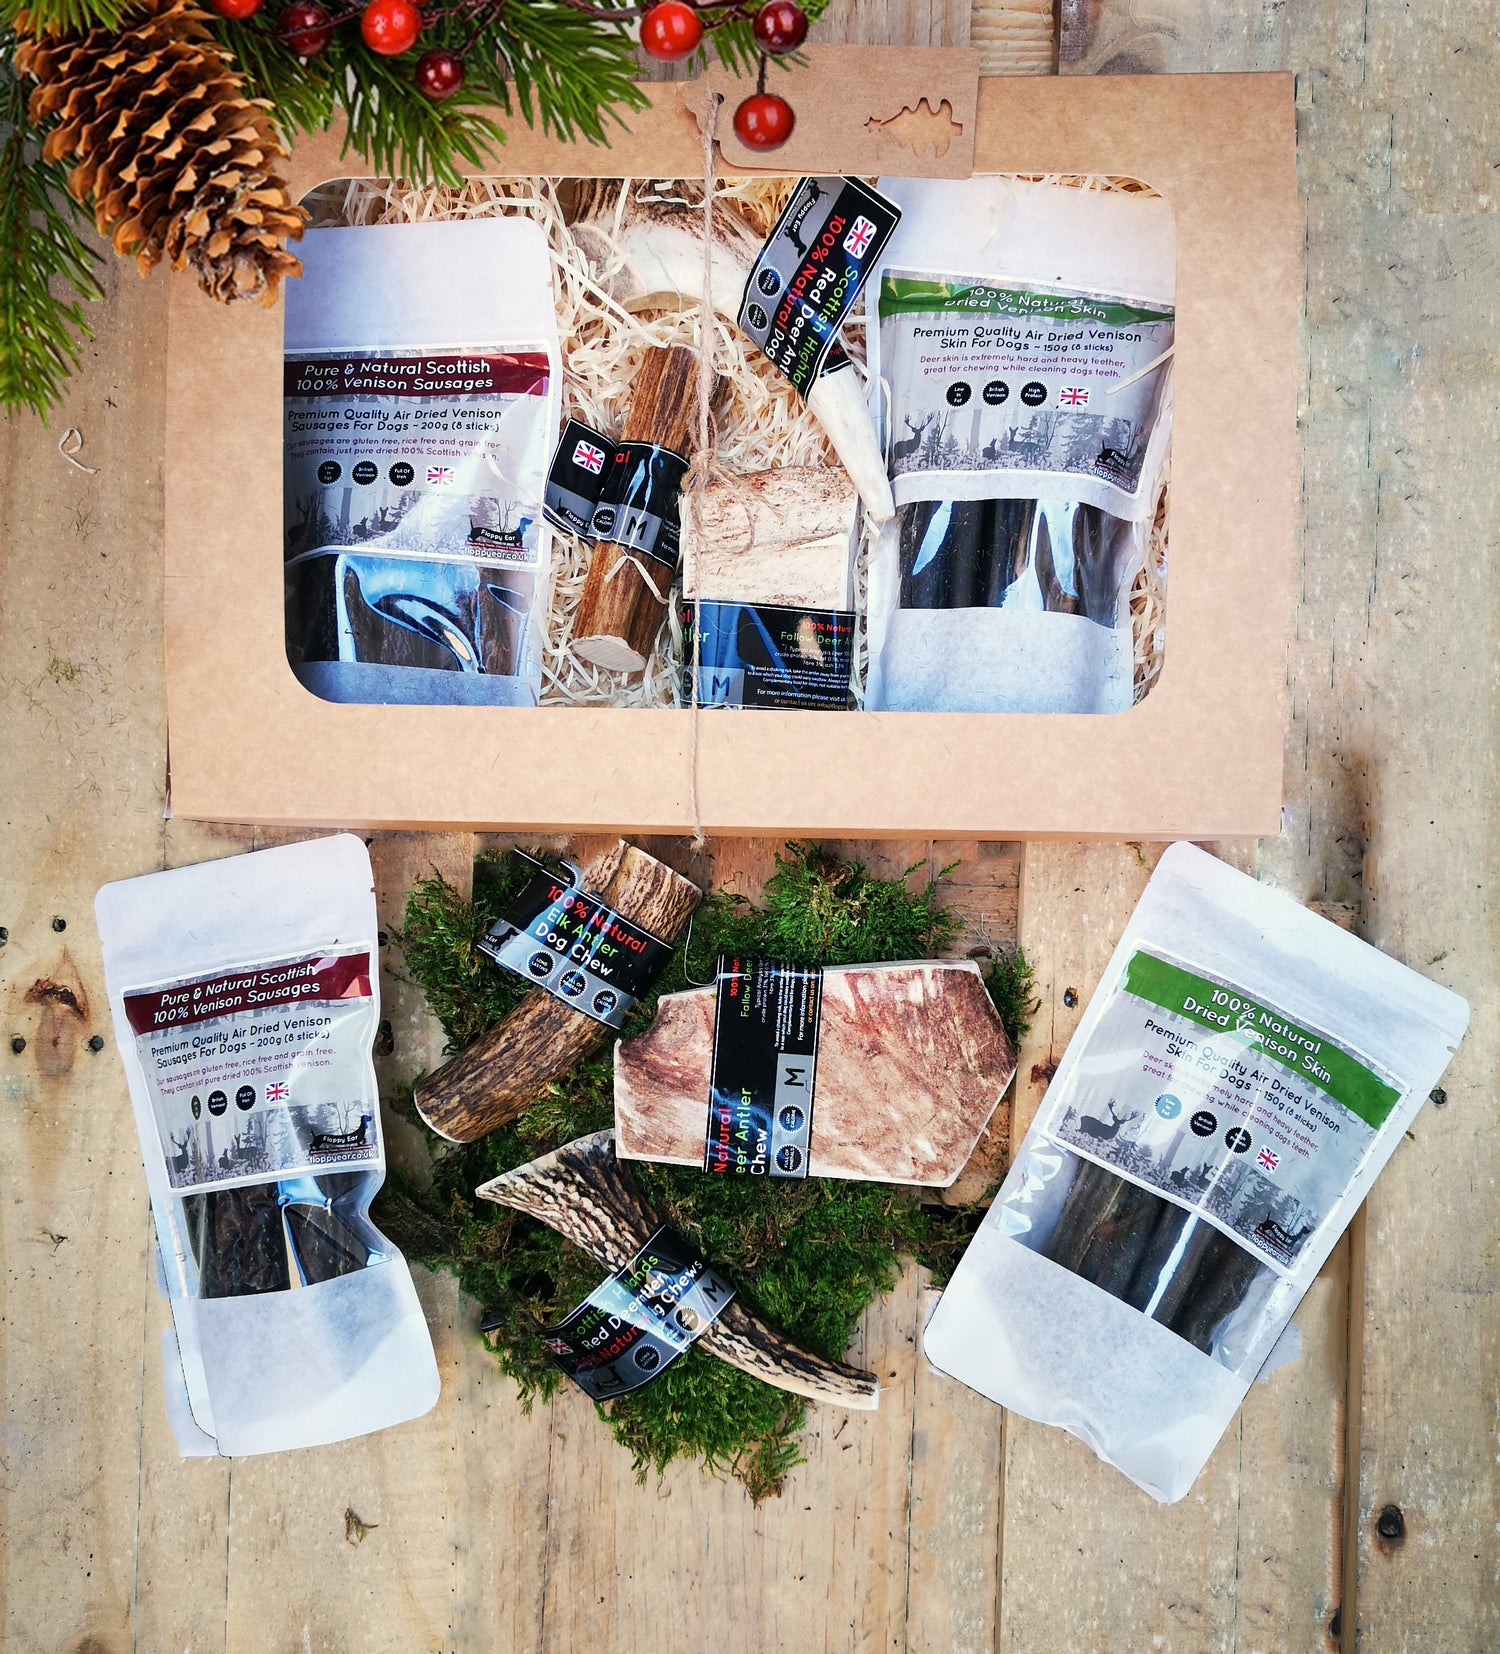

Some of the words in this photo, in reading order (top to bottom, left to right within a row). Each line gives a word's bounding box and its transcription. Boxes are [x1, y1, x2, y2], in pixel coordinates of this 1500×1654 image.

[798, 198, 816, 220] Floppy
[792, 220, 801, 232] Ear
[811, 214, 847, 263] 100%
[776, 263, 818, 330] Natural
[809, 267, 837, 304] Red
[969, 288, 1013, 302] 100%
[813, 265, 858, 333] Scottish
[1070, 304, 1107, 319] Skin
[790, 304, 815, 346] Deer
[913, 327, 969, 337] Premium
[974, 326, 1021, 339] Quality
[1025, 330, 1043, 340] Air
[1048, 330, 1083, 341] Dried
[1089, 330, 1142, 342] Venison
[765, 328, 784, 359] Dog
[940, 338, 967, 348] Skin
[972, 338, 992, 348] For
[996, 338, 1029, 351] Dogs
[1044, 344, 1068, 352] 150g
[1084, 344, 1113, 352] sticks)
[304, 365, 339, 376] Pure
[344, 363, 355, 375] &
[360, 361, 422, 375] Natural
[426, 359, 490, 374] Scottish
[923, 366, 946, 375] great
[963, 364, 999, 372] chewing
[1028, 366, 1067, 374] cleaning
[1070, 367, 1092, 376] dogs
[1096, 369, 1121, 378] teeth.
[1017, 355, 1038, 363] hard
[1061, 356, 1088, 364] heavy
[1092, 357, 1125, 368] teether,
[296, 380, 339, 390] 100%
[344, 376, 407, 390] Venison
[413, 378, 494, 391] Sausages
[289, 410, 339, 420] Premium
[344, 408, 389, 421] Quality
[394, 410, 411, 419] Air
[415, 409, 447, 419] Dried
[452, 409, 501, 419] Venison
[291, 422, 350, 432] Sausages
[354, 421, 373, 430] For
[377, 422, 409, 432] Dogs
[421, 422, 448, 431] 200g
[299, 439, 334, 447] sausages
[336, 447, 352, 455] just
[427, 448, 460, 456] Scottish
[481, 529, 503, 540] Floppy
[626, 516, 648, 540] M
[465, 547, 529, 560] floppyear.co.uk
[781, 631, 813, 642] Fallow
[818, 635, 842, 645] Deer
[711, 674, 730, 697] M
[547, 907, 571, 930] Elk
[572, 926, 619, 958] Antler
[548, 886, 589, 919] 100%
[590, 911, 648, 954] Natural
[535, 922, 568, 951] Dog
[571, 944, 614, 977] Chew
[161, 993, 189, 1006] Pure
[193, 988, 202, 1000] &
[206, 975, 257, 997] Natural
[259, 964, 316, 985] Scottish
[154, 1006, 189, 1024] 100%
[193, 995, 241, 1016] Venison
[247, 983, 320, 1003] Sausages
[741, 985, 751, 1017] Fallow
[1212, 989, 1256, 1019] 100%
[1259, 1013, 1321, 1054] Natural
[151, 1041, 188, 1058] Premium
[192, 1032, 228, 1049] Quality
[232, 1028, 247, 1039] Air
[250, 1022, 280, 1036] Dried
[284, 1016, 331, 1030] Venison
[1183, 997, 1230, 1027] Dried
[1236, 1019, 1297, 1061] Venison
[1302, 1055, 1331, 1083] Skin
[156, 1052, 197, 1069] Sausages
[200, 1048, 215, 1058] For
[219, 1042, 246, 1054] Dogs
[257, 1037, 281, 1048] 200g
[202, 1064, 223, 1075] gluten
[242, 1058, 256, 1067] rice
[258, 1055, 272, 1063] free
[274, 1052, 288, 1060] and
[205, 1075, 221, 1085] pure
[222, 1071, 241, 1080] dried
[243, 1068, 262, 1076] 100%
[263, 1063, 293, 1073] Scottish
[784, 1068, 805, 1086] M
[1144, 1019, 1198, 1051] Premium
[1202, 1047, 1247, 1075] Quality
[1250, 1070, 1269, 1083] Air
[1271, 1079, 1302, 1104] Dried
[1304, 1100, 1341, 1133] Venison
[1166, 1043, 1192, 1062] Skin
[1196, 1057, 1216, 1073] For
[1219, 1070, 1252, 1091] Dogs
[1264, 1091, 1285, 1111] 150g
[1294, 1114, 1317, 1132] sticks)
[735, 1088, 752, 1141] Antler
[1218, 1100, 1240, 1113] while
[1275, 1131, 1290, 1145] dogs
[1256, 1106, 1272, 1118] and
[1274, 1115, 1292, 1133] heavy
[714, 1108, 732, 1172] Natural
[750, 1128, 768, 1174] Chew
[309, 1151, 374, 1163] floppyear.co.uk
[736, 1147, 747, 1173] eer
[661, 1260, 703, 1303] Chews
[702, 1278, 726, 1303] M
[582, 1329, 609, 1351] Red
